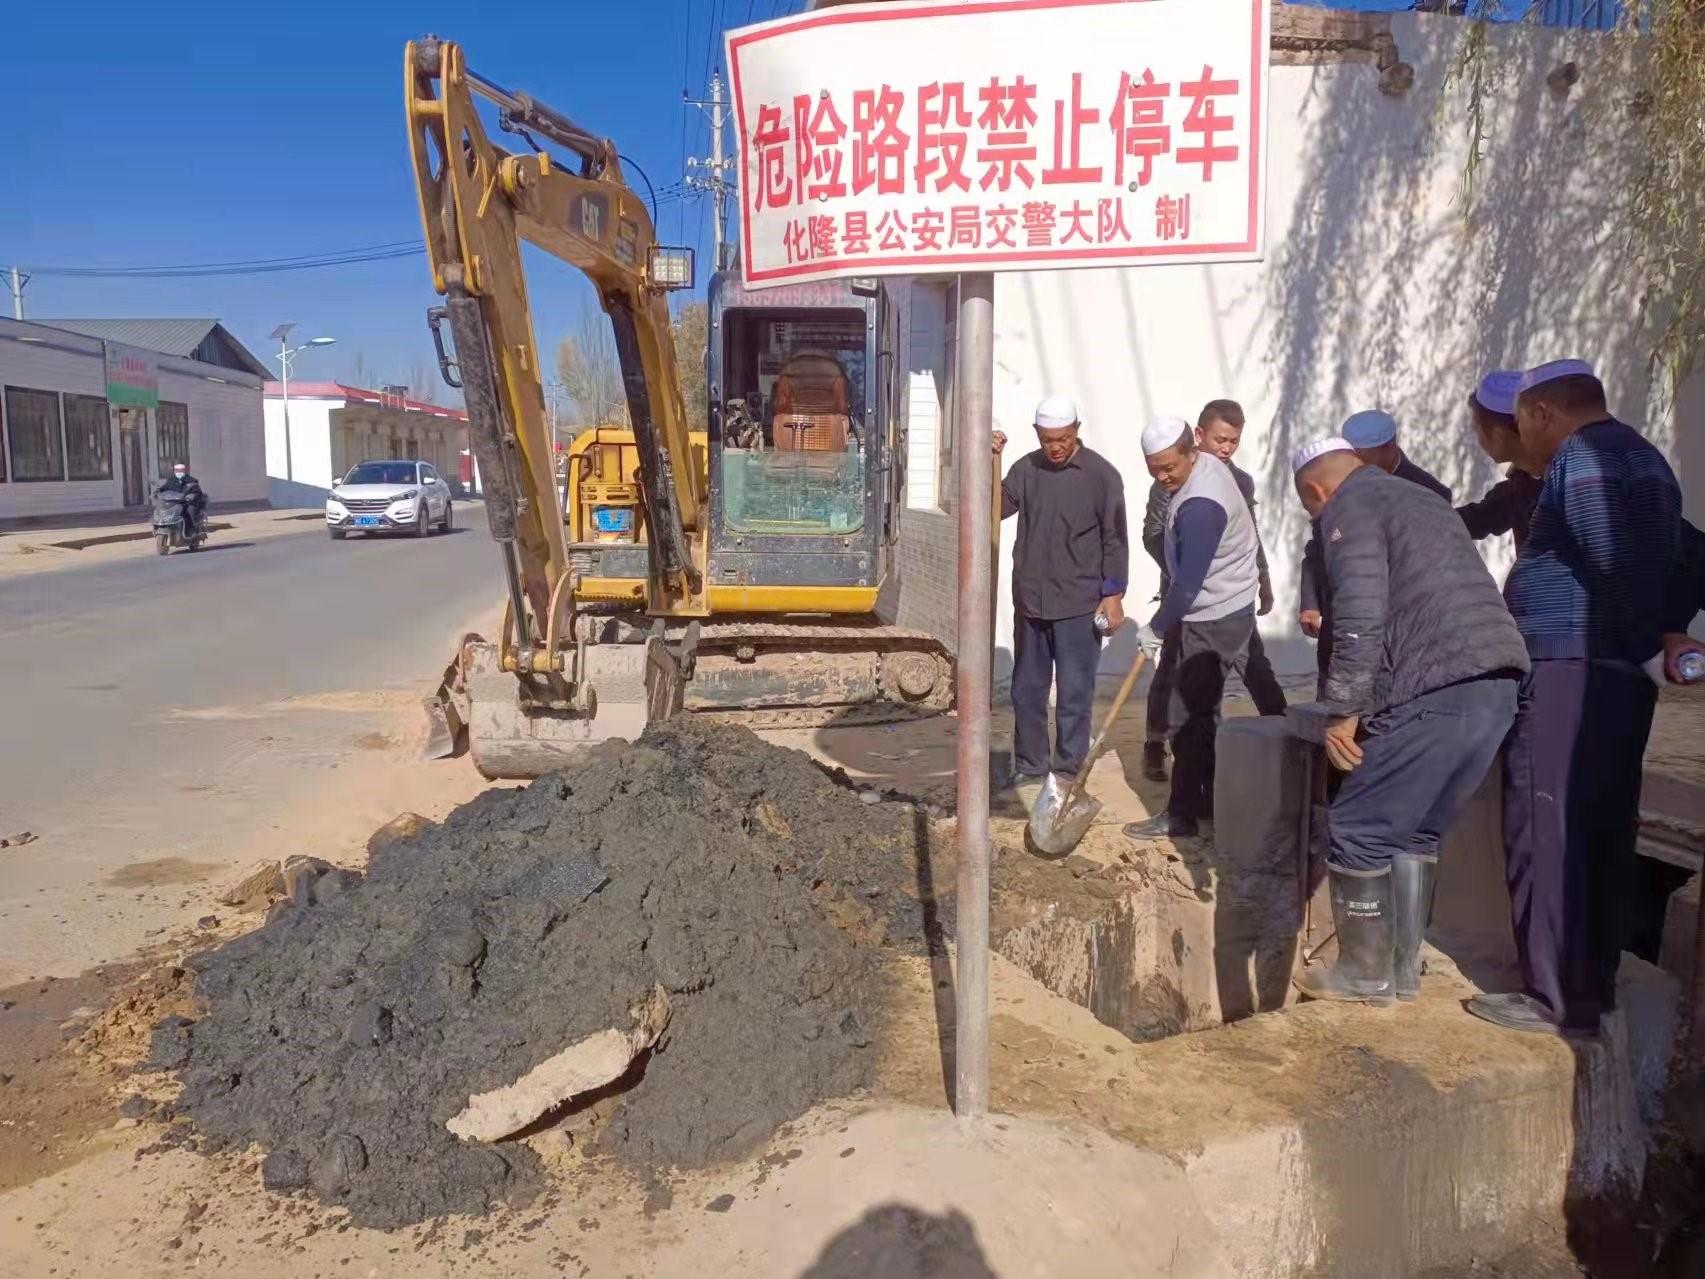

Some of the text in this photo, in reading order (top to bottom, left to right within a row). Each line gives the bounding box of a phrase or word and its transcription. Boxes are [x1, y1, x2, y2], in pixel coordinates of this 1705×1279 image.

[753, 64, 1239, 212] 危险路段禁止停车
[783, 193, 1190, 264] 化隆县公安局交警大队 制
